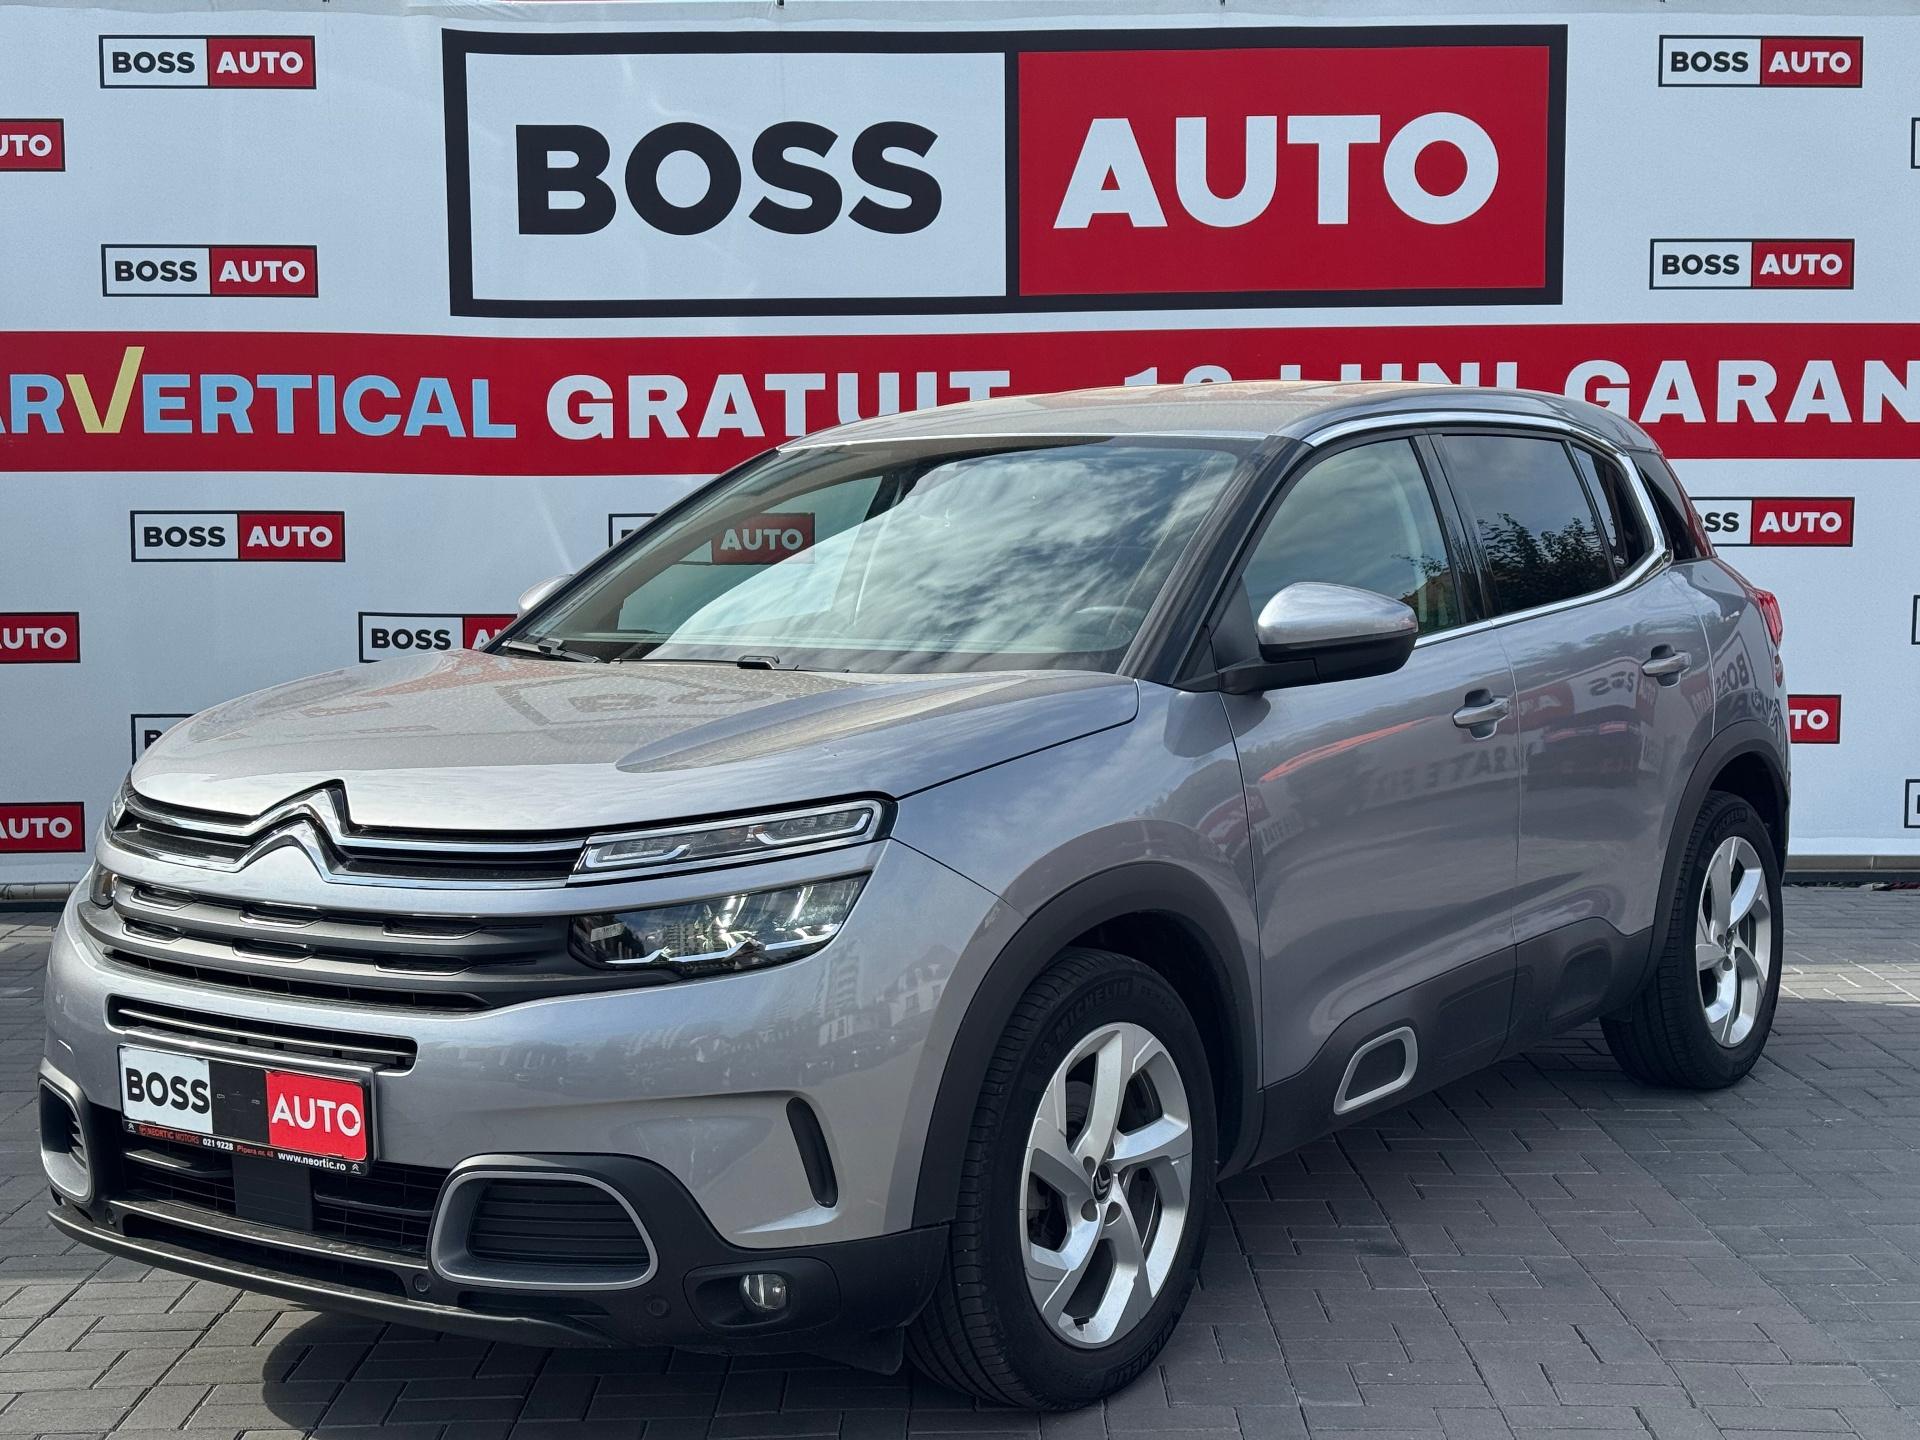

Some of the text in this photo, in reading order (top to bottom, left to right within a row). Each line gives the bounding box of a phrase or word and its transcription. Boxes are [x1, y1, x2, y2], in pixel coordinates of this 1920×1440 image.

[112, 51, 304, 74] BOSS AUTO
[1670, 51, 1851, 73] BOSS AUTO
[515, 111, 1499, 236] BOSS AUTO
[114, 260, 306, 283] BOSS AUTO
[1661, 254, 1843, 276] BOSS AUTO
[0, 346, 517, 438] RVERTICAL
[1564, 360, 1920, 424] GARAN
[1698, 511, 1842, 533] SS AUTO
[143, 525, 333, 548] BOSS AUTO
[719, 528, 804, 551] AUTO
[0, 627, 67, 650] UTO
[371, 628, 452, 650] BOSS
[125, 1067, 361, 1136] BOSS AUTO
[175, 1131, 199, 1145] MOTORS
[216, 1140, 234, 1151] 9228
[277, 1152, 347, 1172] www.neortic.ro
